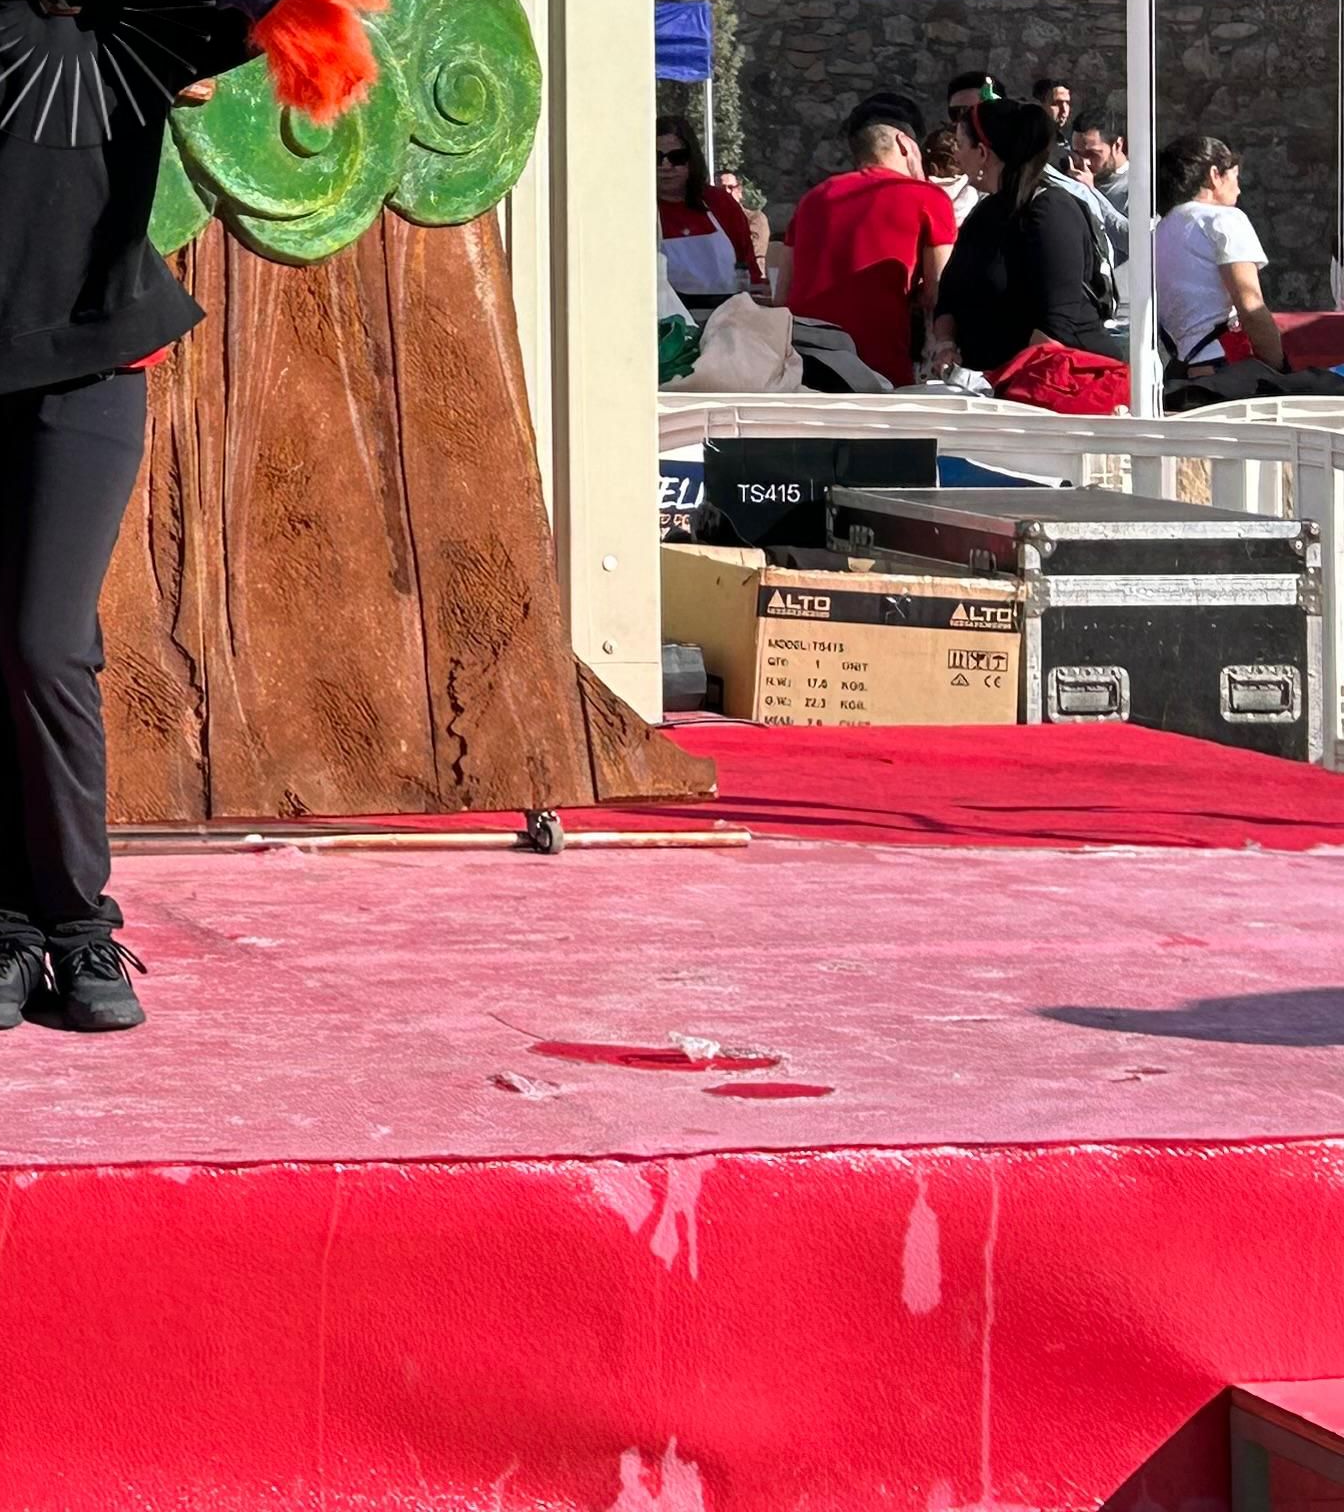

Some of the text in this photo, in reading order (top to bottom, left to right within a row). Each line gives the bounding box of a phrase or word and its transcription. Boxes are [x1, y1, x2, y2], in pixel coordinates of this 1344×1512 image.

[737, 484, 800, 503] TS415
[768, 589, 830, 611] ALTO
[952, 602, 1012, 622] ALTO
